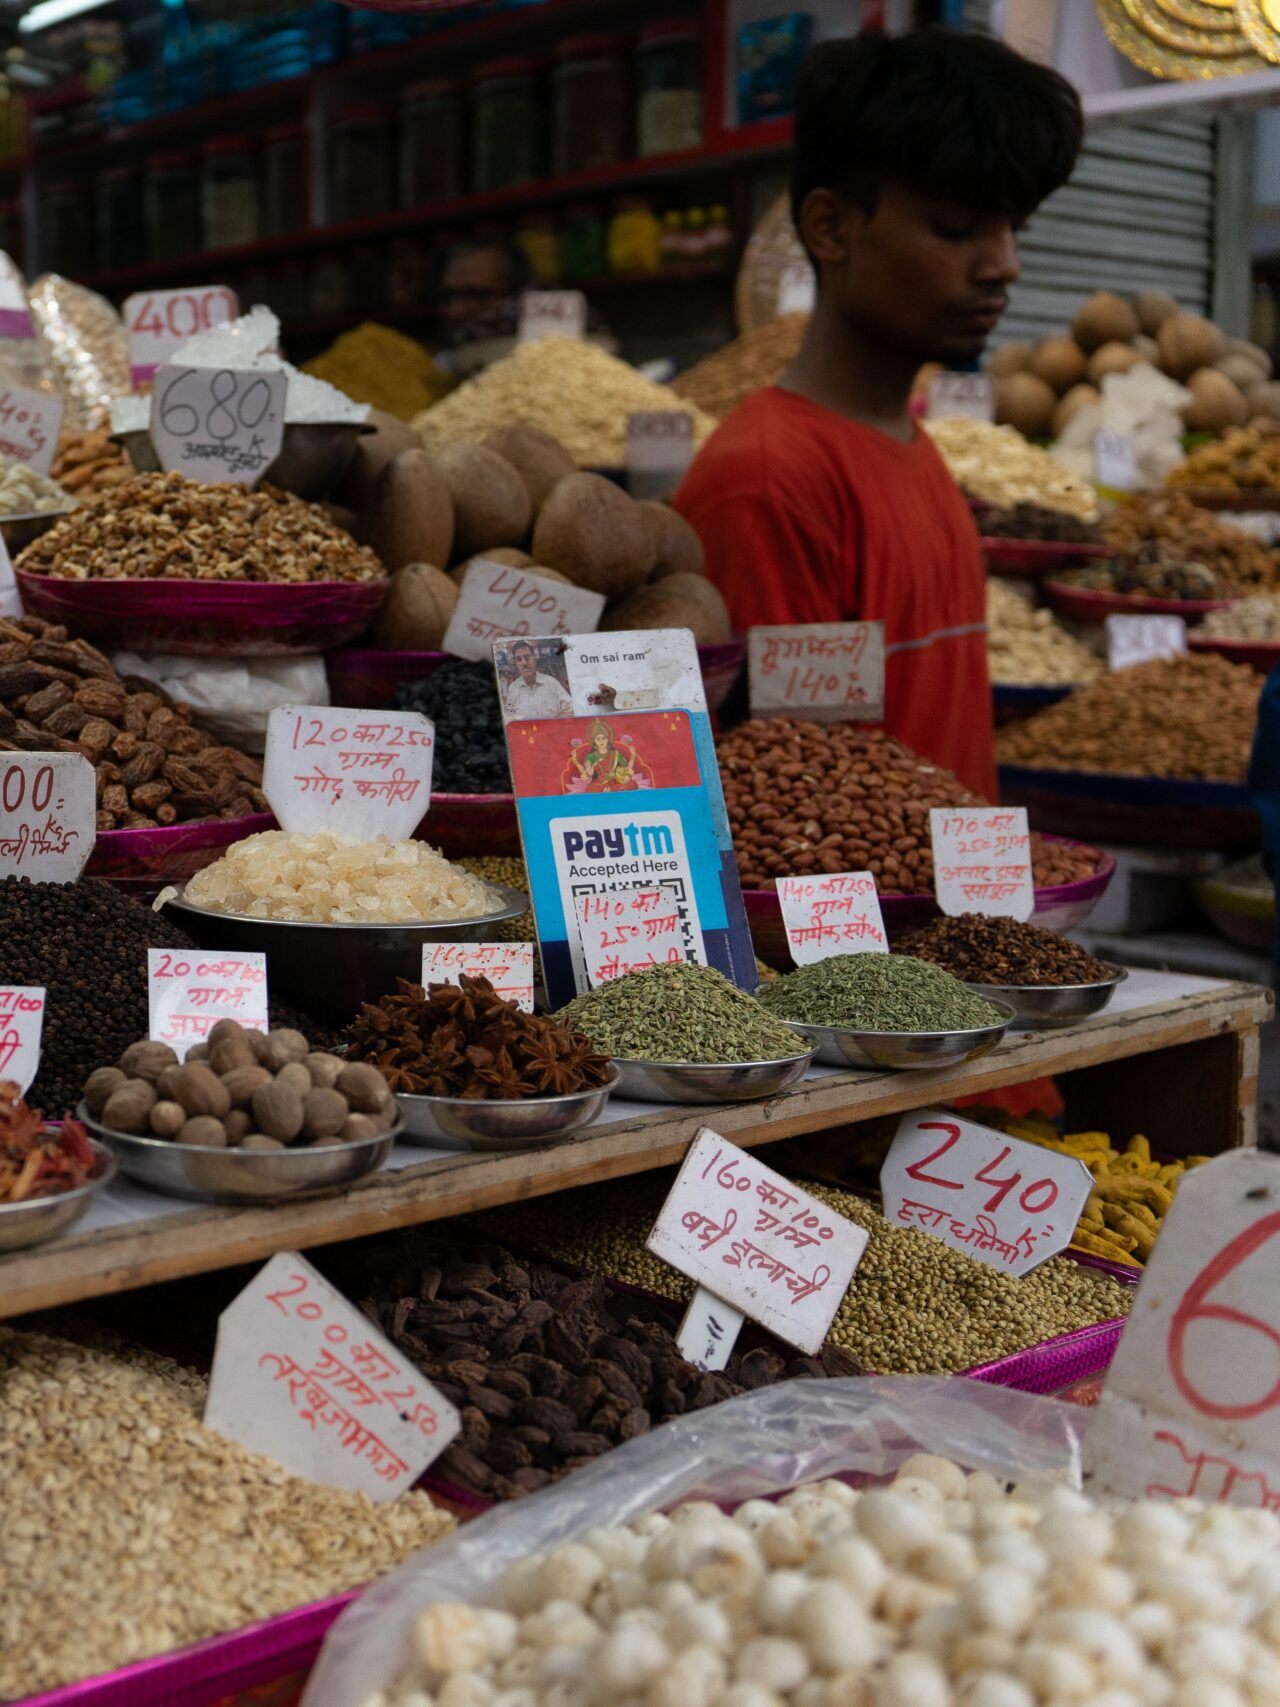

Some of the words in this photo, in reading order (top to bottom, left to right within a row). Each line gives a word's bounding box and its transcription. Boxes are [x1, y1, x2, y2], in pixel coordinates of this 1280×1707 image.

[132, 289, 238, 338] 400
[580, 653, 600, 665] Om
[602, 651, 620, 663] sai
[622, 652, 646, 662] ram
[293, 715, 348, 750] 120
[352, 724, 391, 743] का
[386, 726, 433, 747] 250
[338, 752, 401, 771] ग्राम
[569, 863, 640, 878] Accepted
[642, 859, 678, 873] Here
[783, 880, 815, 902] 140
[583, 897, 625, 922] 140
[600, 926, 640, 949] 250
[153, 954, 210, 977] 200
[905, 1122, 1059, 1214] 240
[702, 1148, 751, 1192] 160
[756, 1180, 799, 1209] का
[791, 1208, 835, 1240] 100
[897, 1198, 952, 1228] हरा
[265, 1274, 348, 1344] 200
[349, 1341, 401, 1381] का
